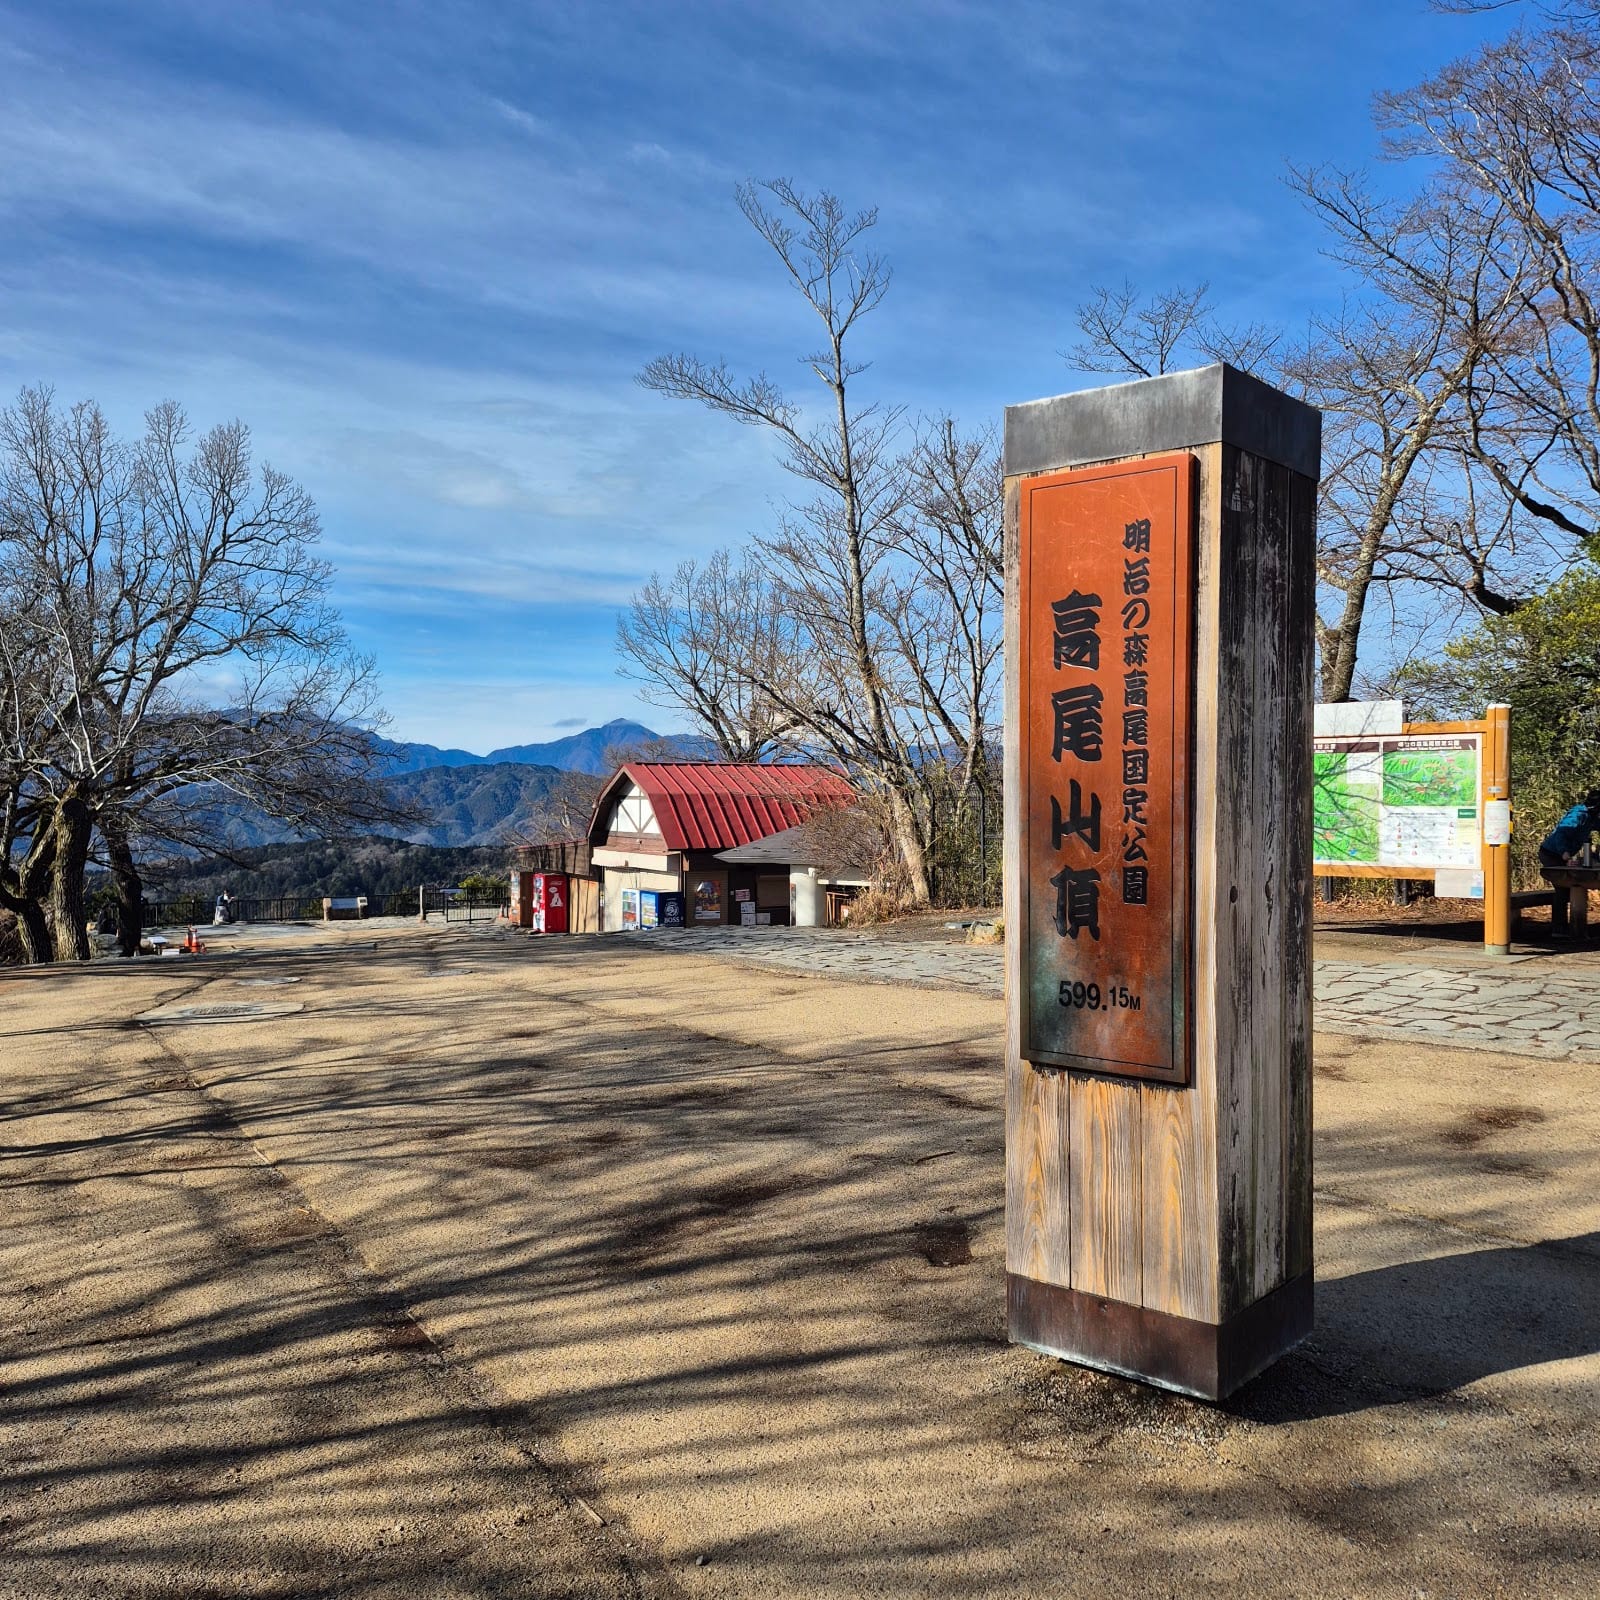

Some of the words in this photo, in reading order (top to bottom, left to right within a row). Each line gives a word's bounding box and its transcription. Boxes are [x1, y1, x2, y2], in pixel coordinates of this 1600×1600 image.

[1051, 589, 1104, 941] 高尾山頂
[1121, 518, 1151, 905] 明治の森高尾国定公園
